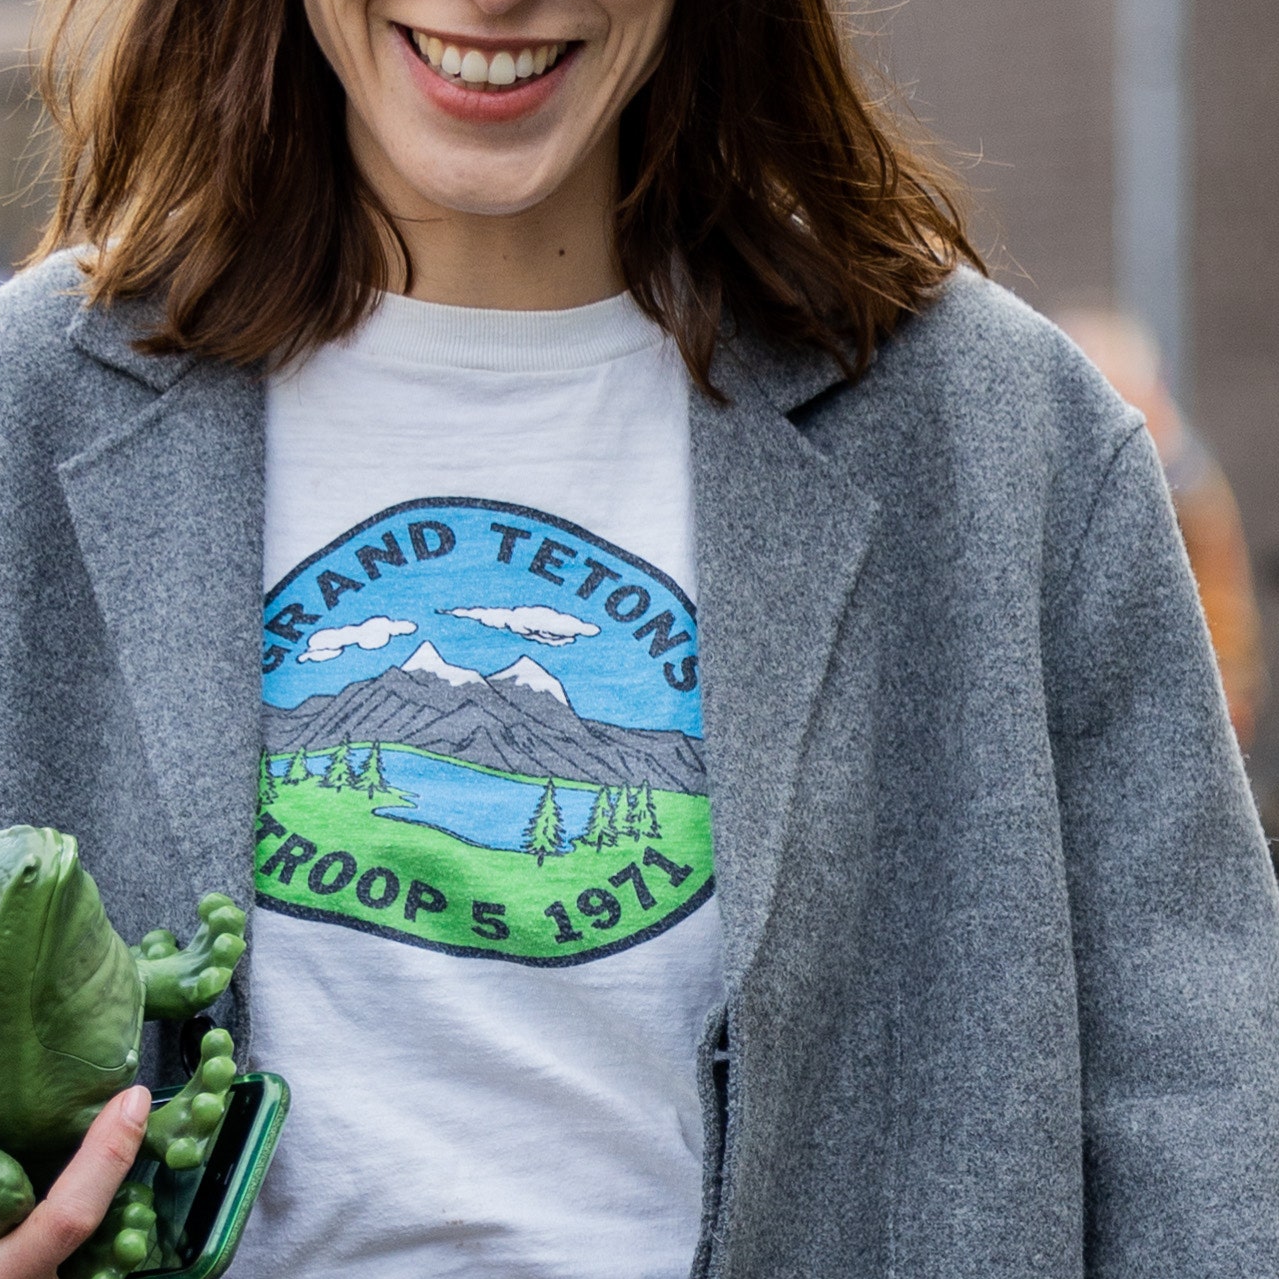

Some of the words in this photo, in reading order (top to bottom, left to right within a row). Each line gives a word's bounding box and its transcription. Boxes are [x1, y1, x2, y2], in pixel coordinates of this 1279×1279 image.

[489, 521, 700, 693] TETONS
[471, 899, 512, 942] 5
[543, 845, 695, 945] 1971
